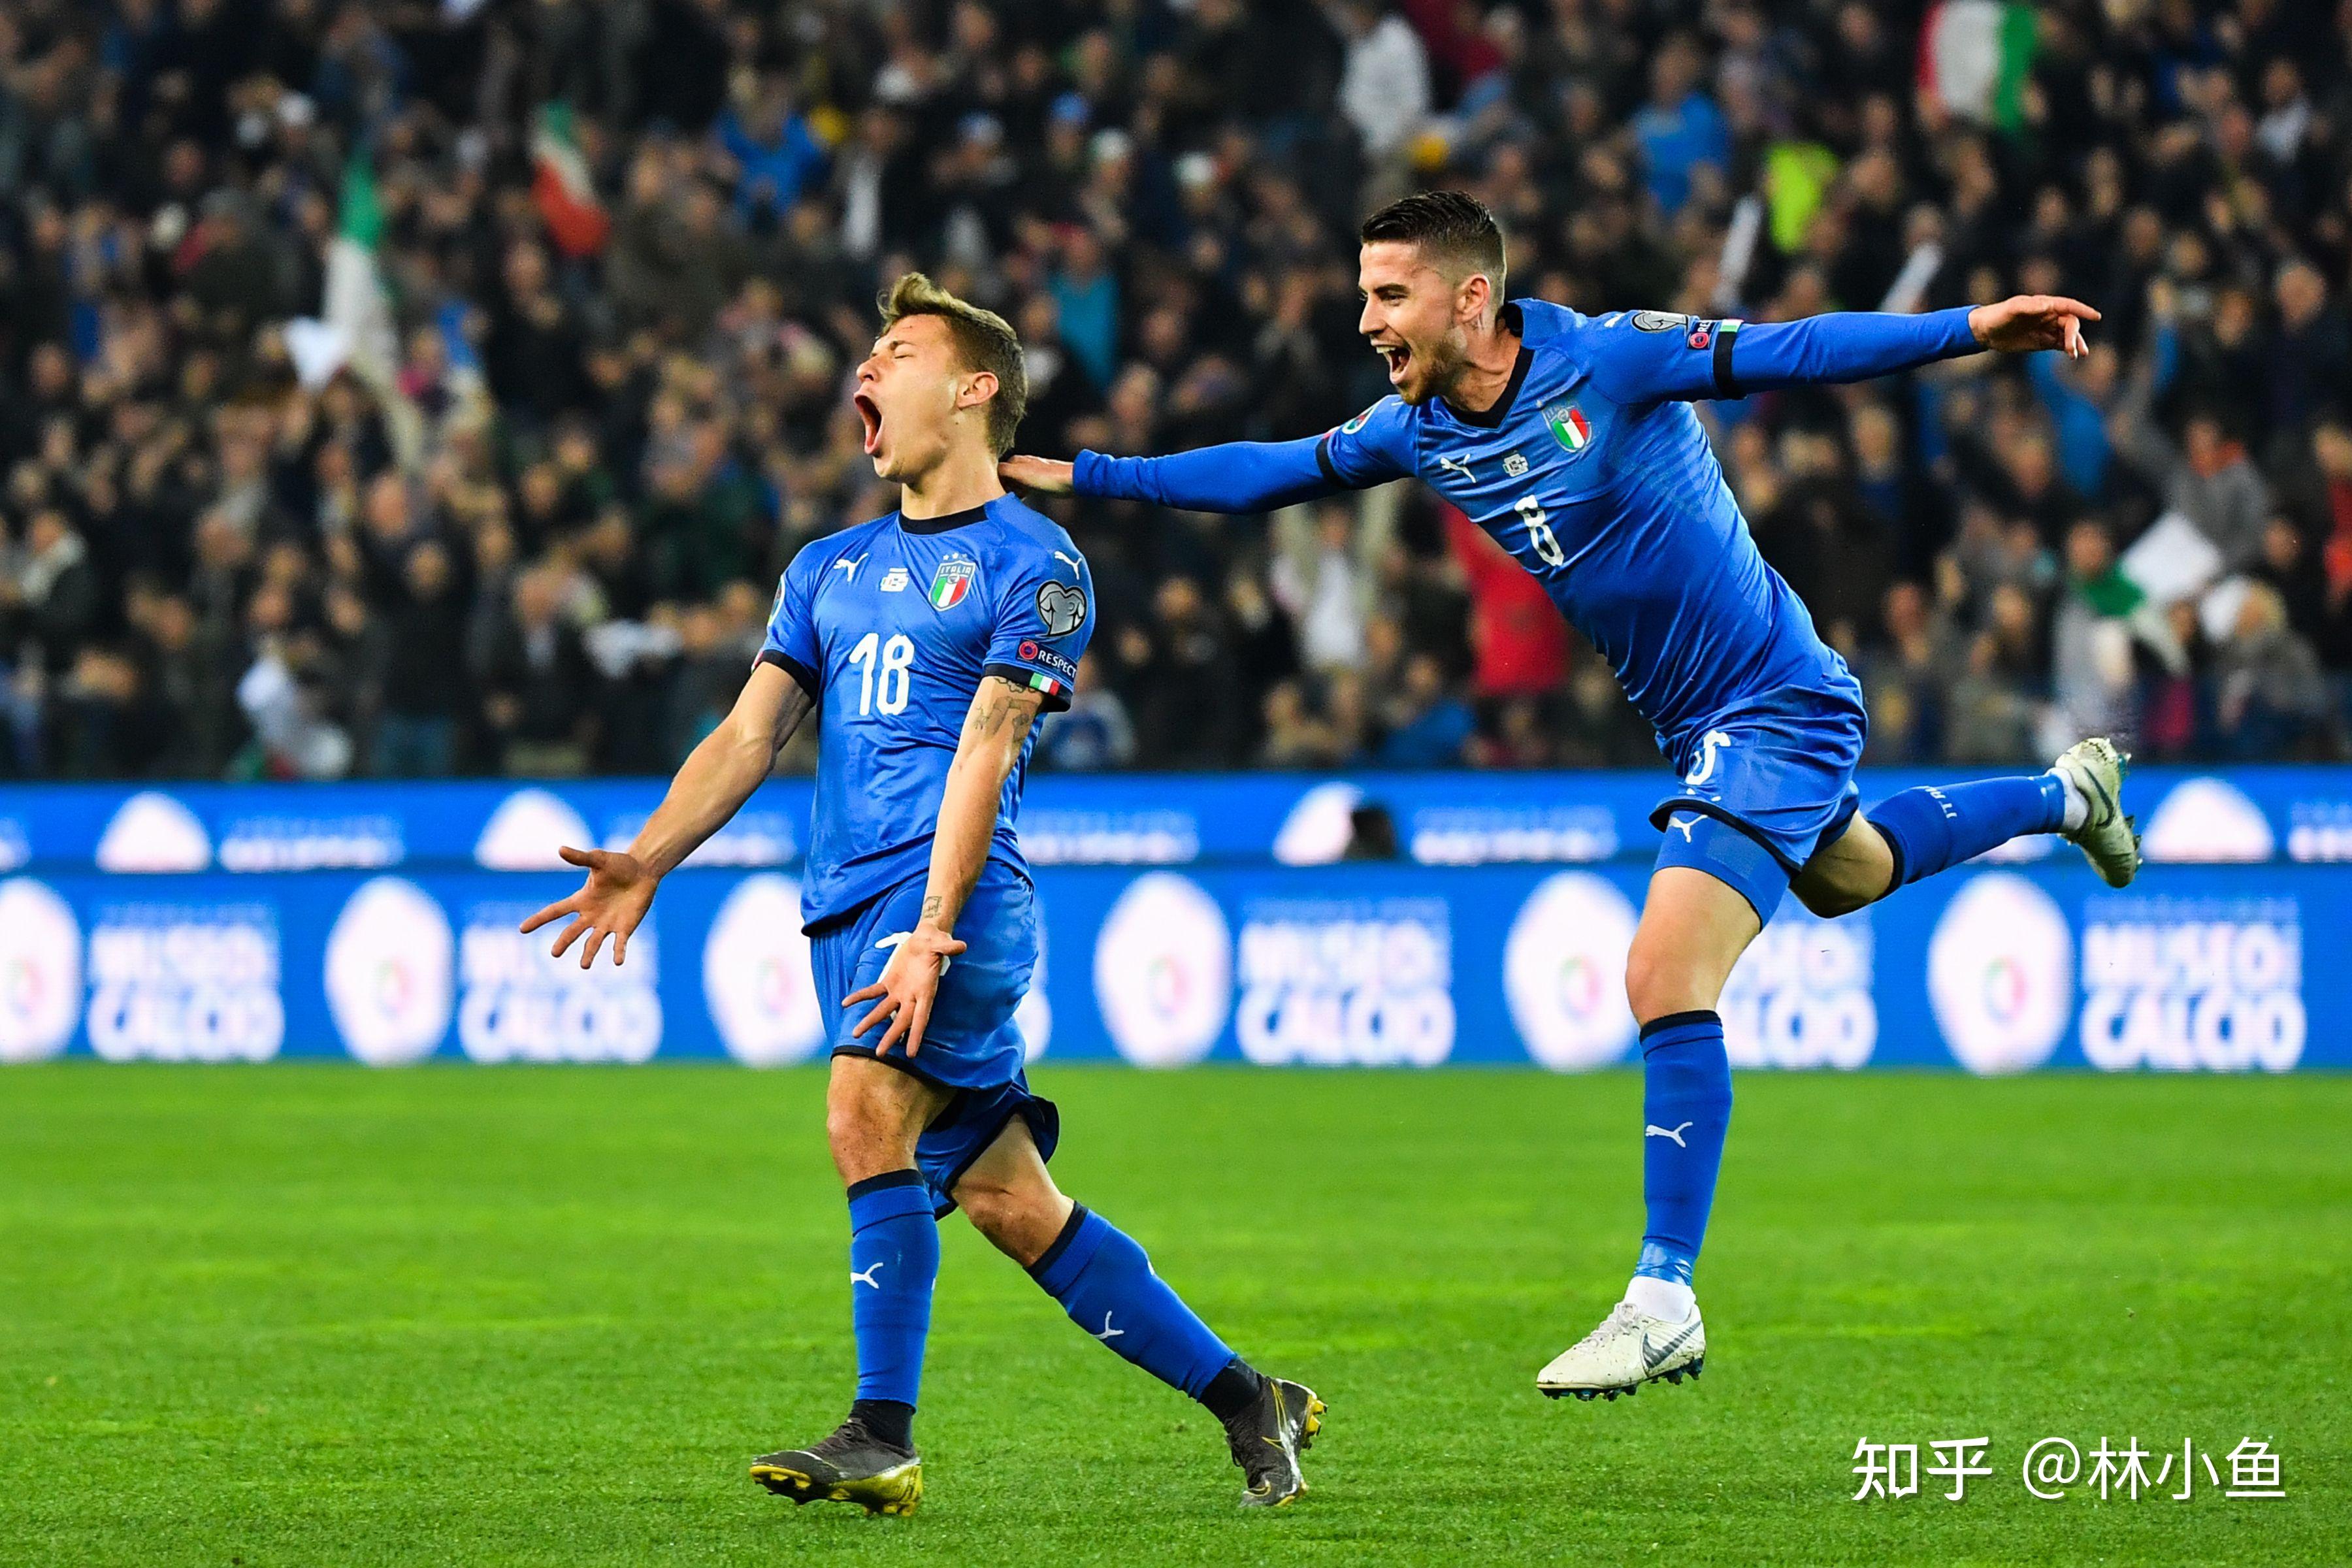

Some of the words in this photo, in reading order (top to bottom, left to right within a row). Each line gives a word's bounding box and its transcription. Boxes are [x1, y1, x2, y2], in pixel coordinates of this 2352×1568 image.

[1514, 495, 1564, 566] 8
[940, 565, 972, 574] ITALIA
[849, 632, 915, 715] 18
[1038, 650, 1077, 678] RESPECT
[2082, 923, 2287, 989] MUSEO
[1236, 984, 1456, 1066] CALCIO
[2080, 987, 2307, 1071] CALCIO
